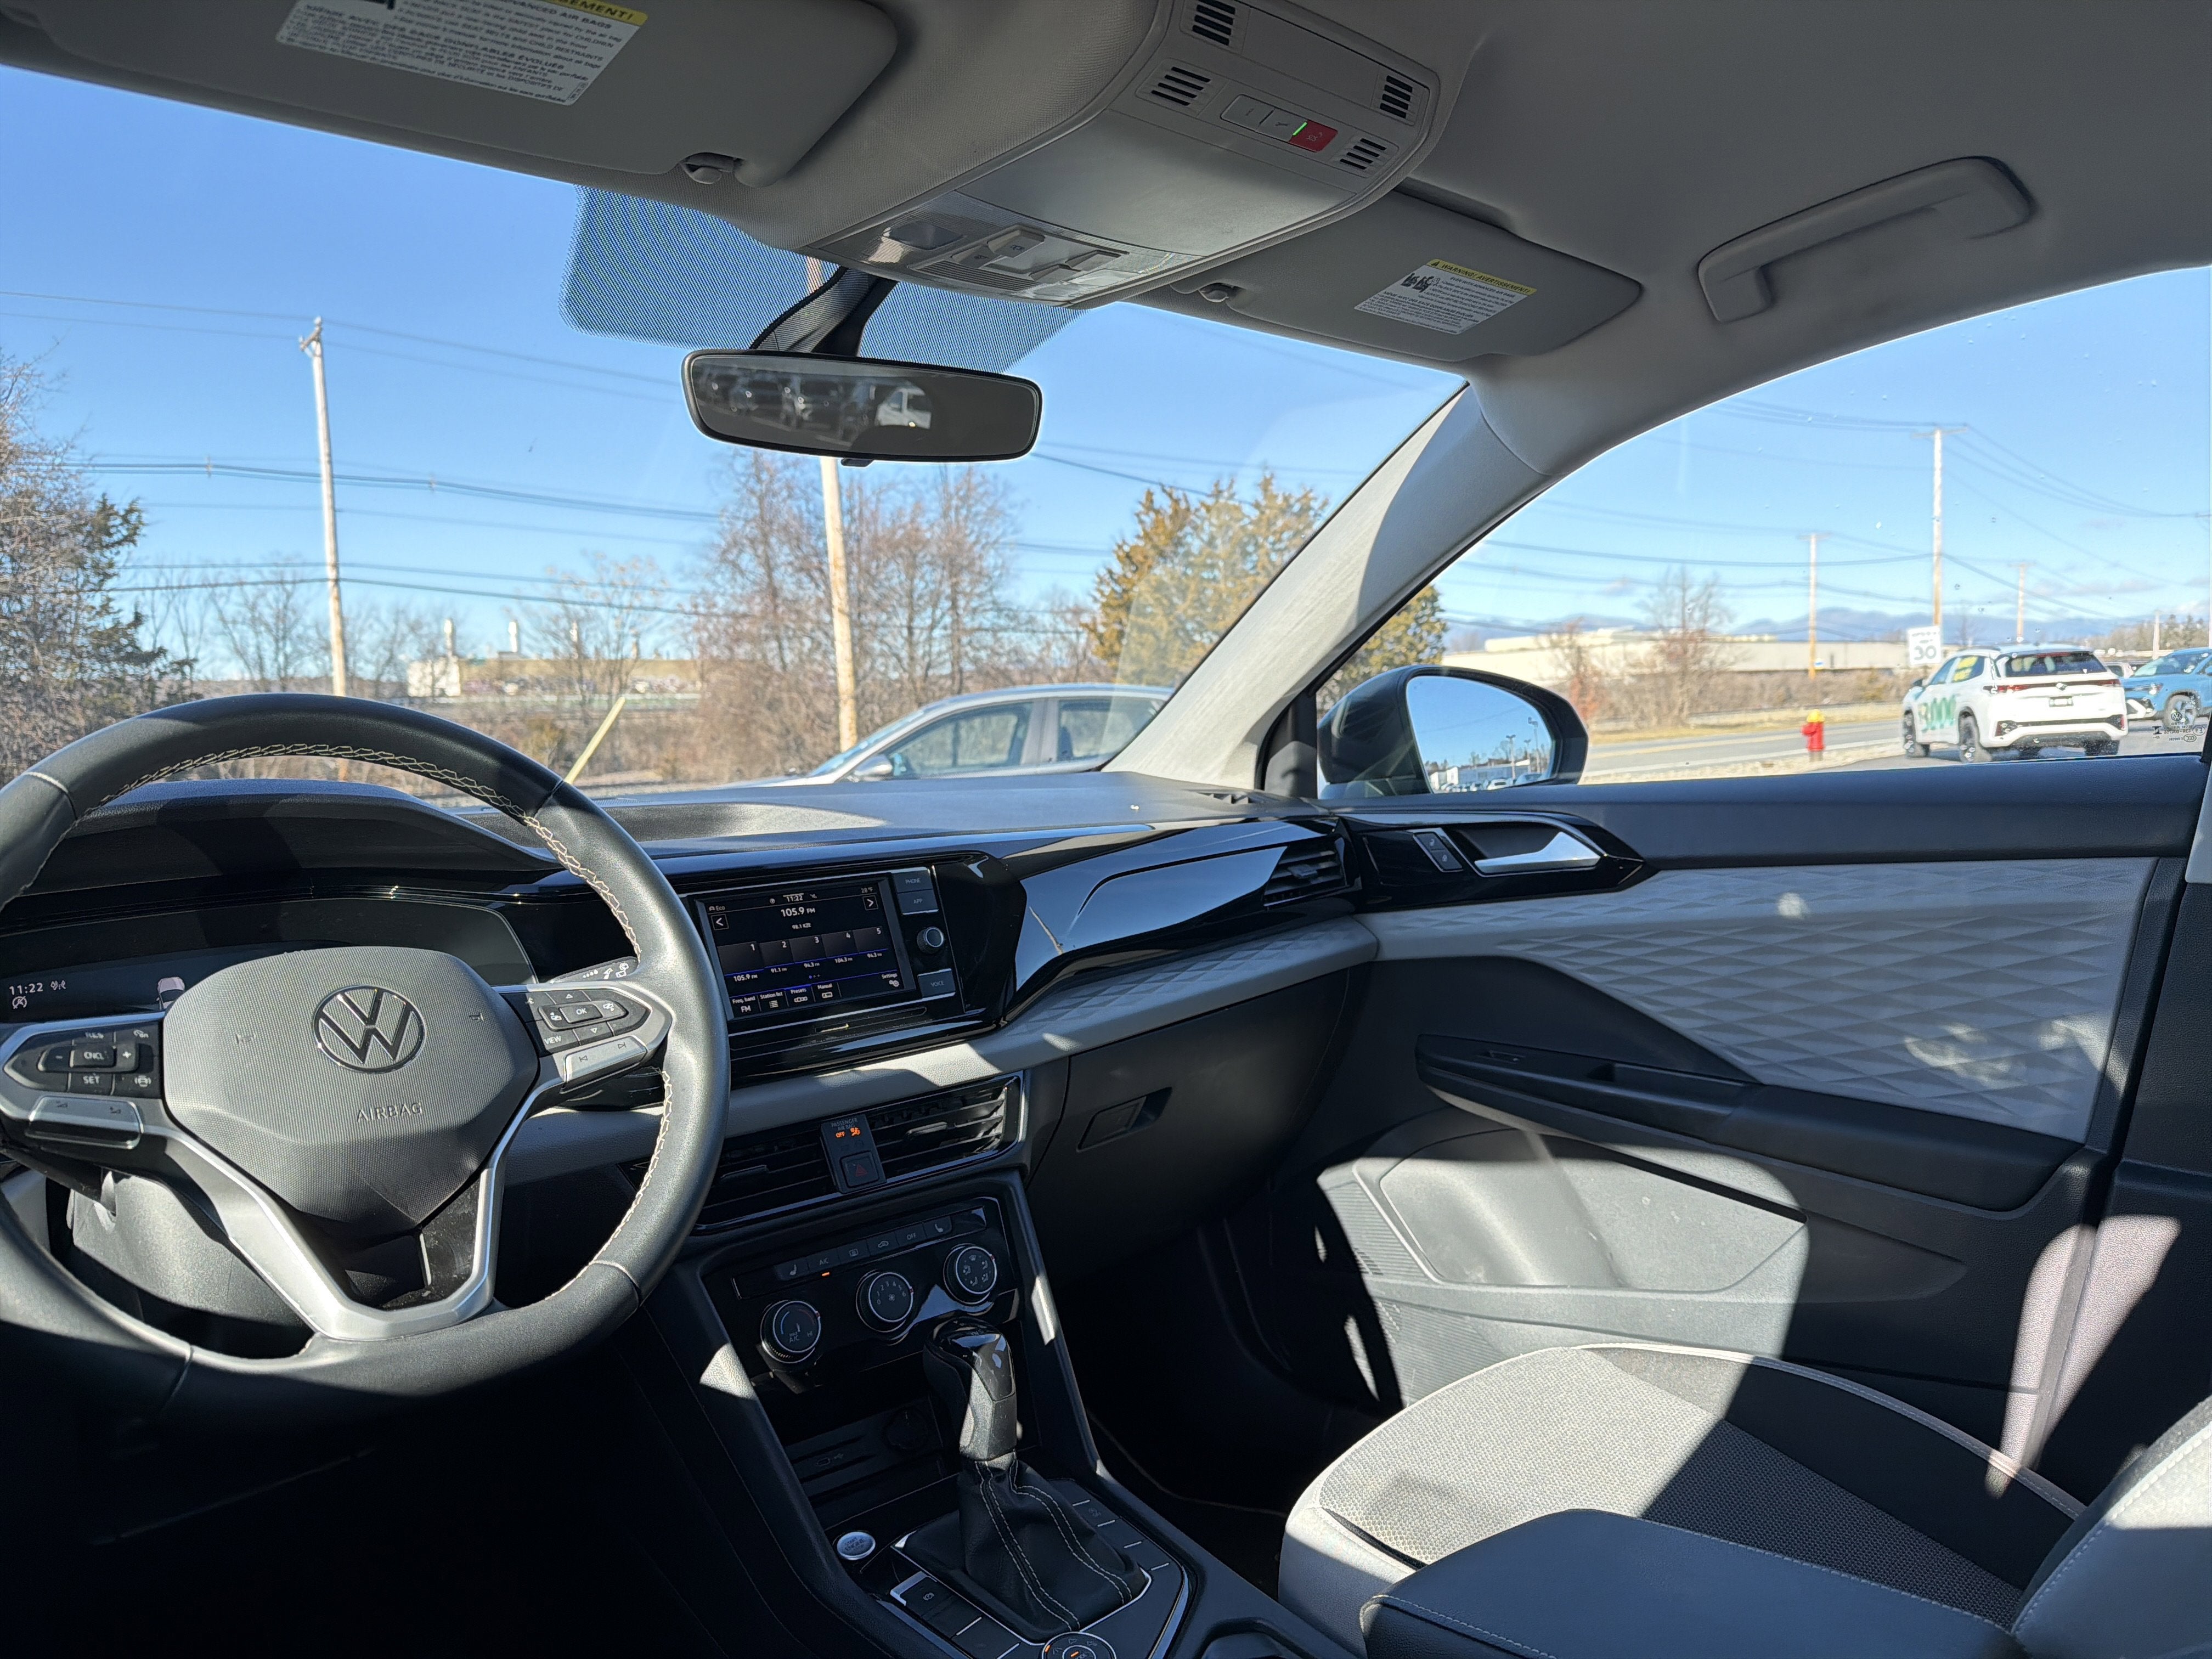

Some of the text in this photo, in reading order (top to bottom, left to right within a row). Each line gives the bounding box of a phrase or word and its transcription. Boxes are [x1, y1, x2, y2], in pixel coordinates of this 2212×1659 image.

[560, 12, 579, 21] AIR
[582, 18, 612, 29] BAGS
[575, 35, 614, 48] CHILDREN
[555, 46, 603, 62] RESTRAINTS
[1442, 263, 1531, 294] WARNING! AVERTISSEMENT!
[1914, 645, 1937, 660] 30
[780, 906, 805, 918] 105.9
[733, 974, 751, 982] 105.9
[9, 983, 44, 995] 11:22
[544, 1035, 561, 1045] VIEW
[83, 1075, 100, 1084] SET
[357, 1102, 422, 1122] AIRBAG
[831, 1118, 858, 1127] PASSENGER
[907, 1232, 916, 1240] OFF
